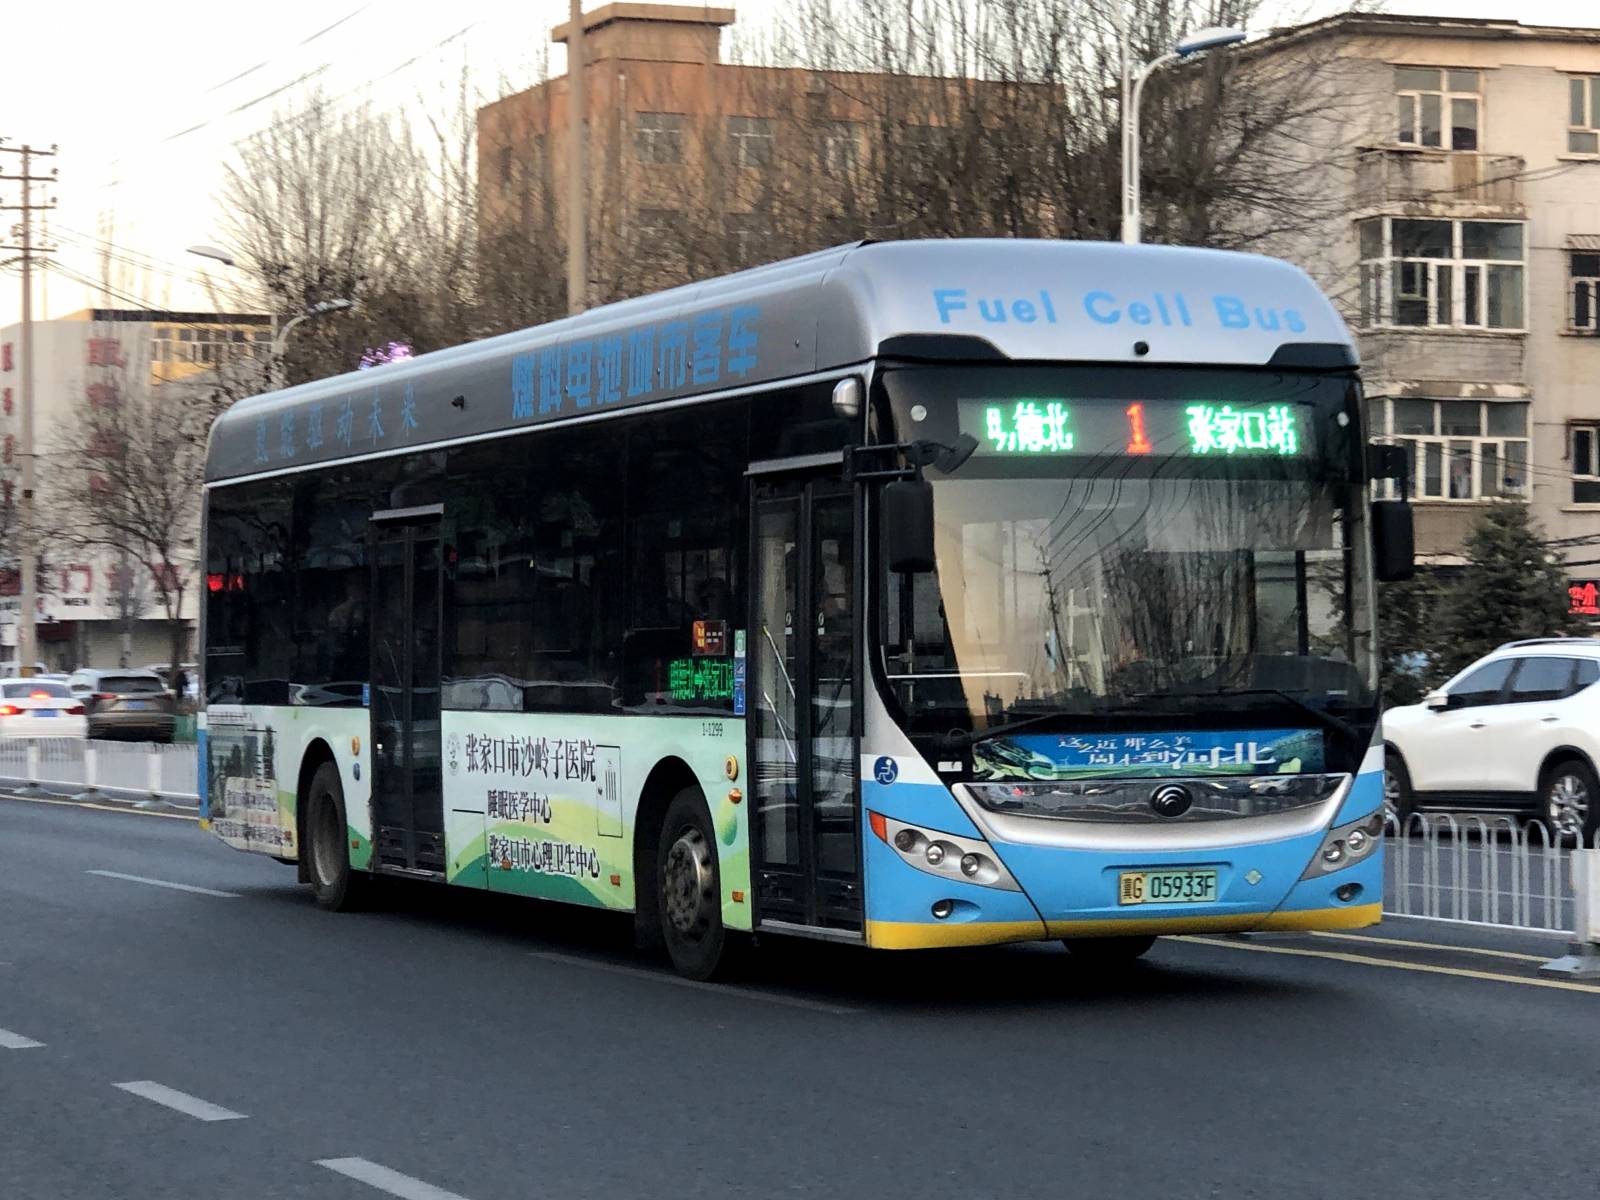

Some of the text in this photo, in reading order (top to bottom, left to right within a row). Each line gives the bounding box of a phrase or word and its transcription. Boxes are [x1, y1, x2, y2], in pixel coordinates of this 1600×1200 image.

[933, 289, 1307, 333] Fuel Cell Bus
[512, 305, 762, 420] 燃料电池城市客车
[1126, 402, 1153, 455] 1
[1186, 405, 1297, 454] 张家口站
[465, 733, 597, 783] 张家口市沙岭子医院
[487, 789, 552, 824] 睡眠医学中心
[489, 834, 600, 879] 张家口市心理卫生中心
[1151, 875, 1215, 898] 05933F
